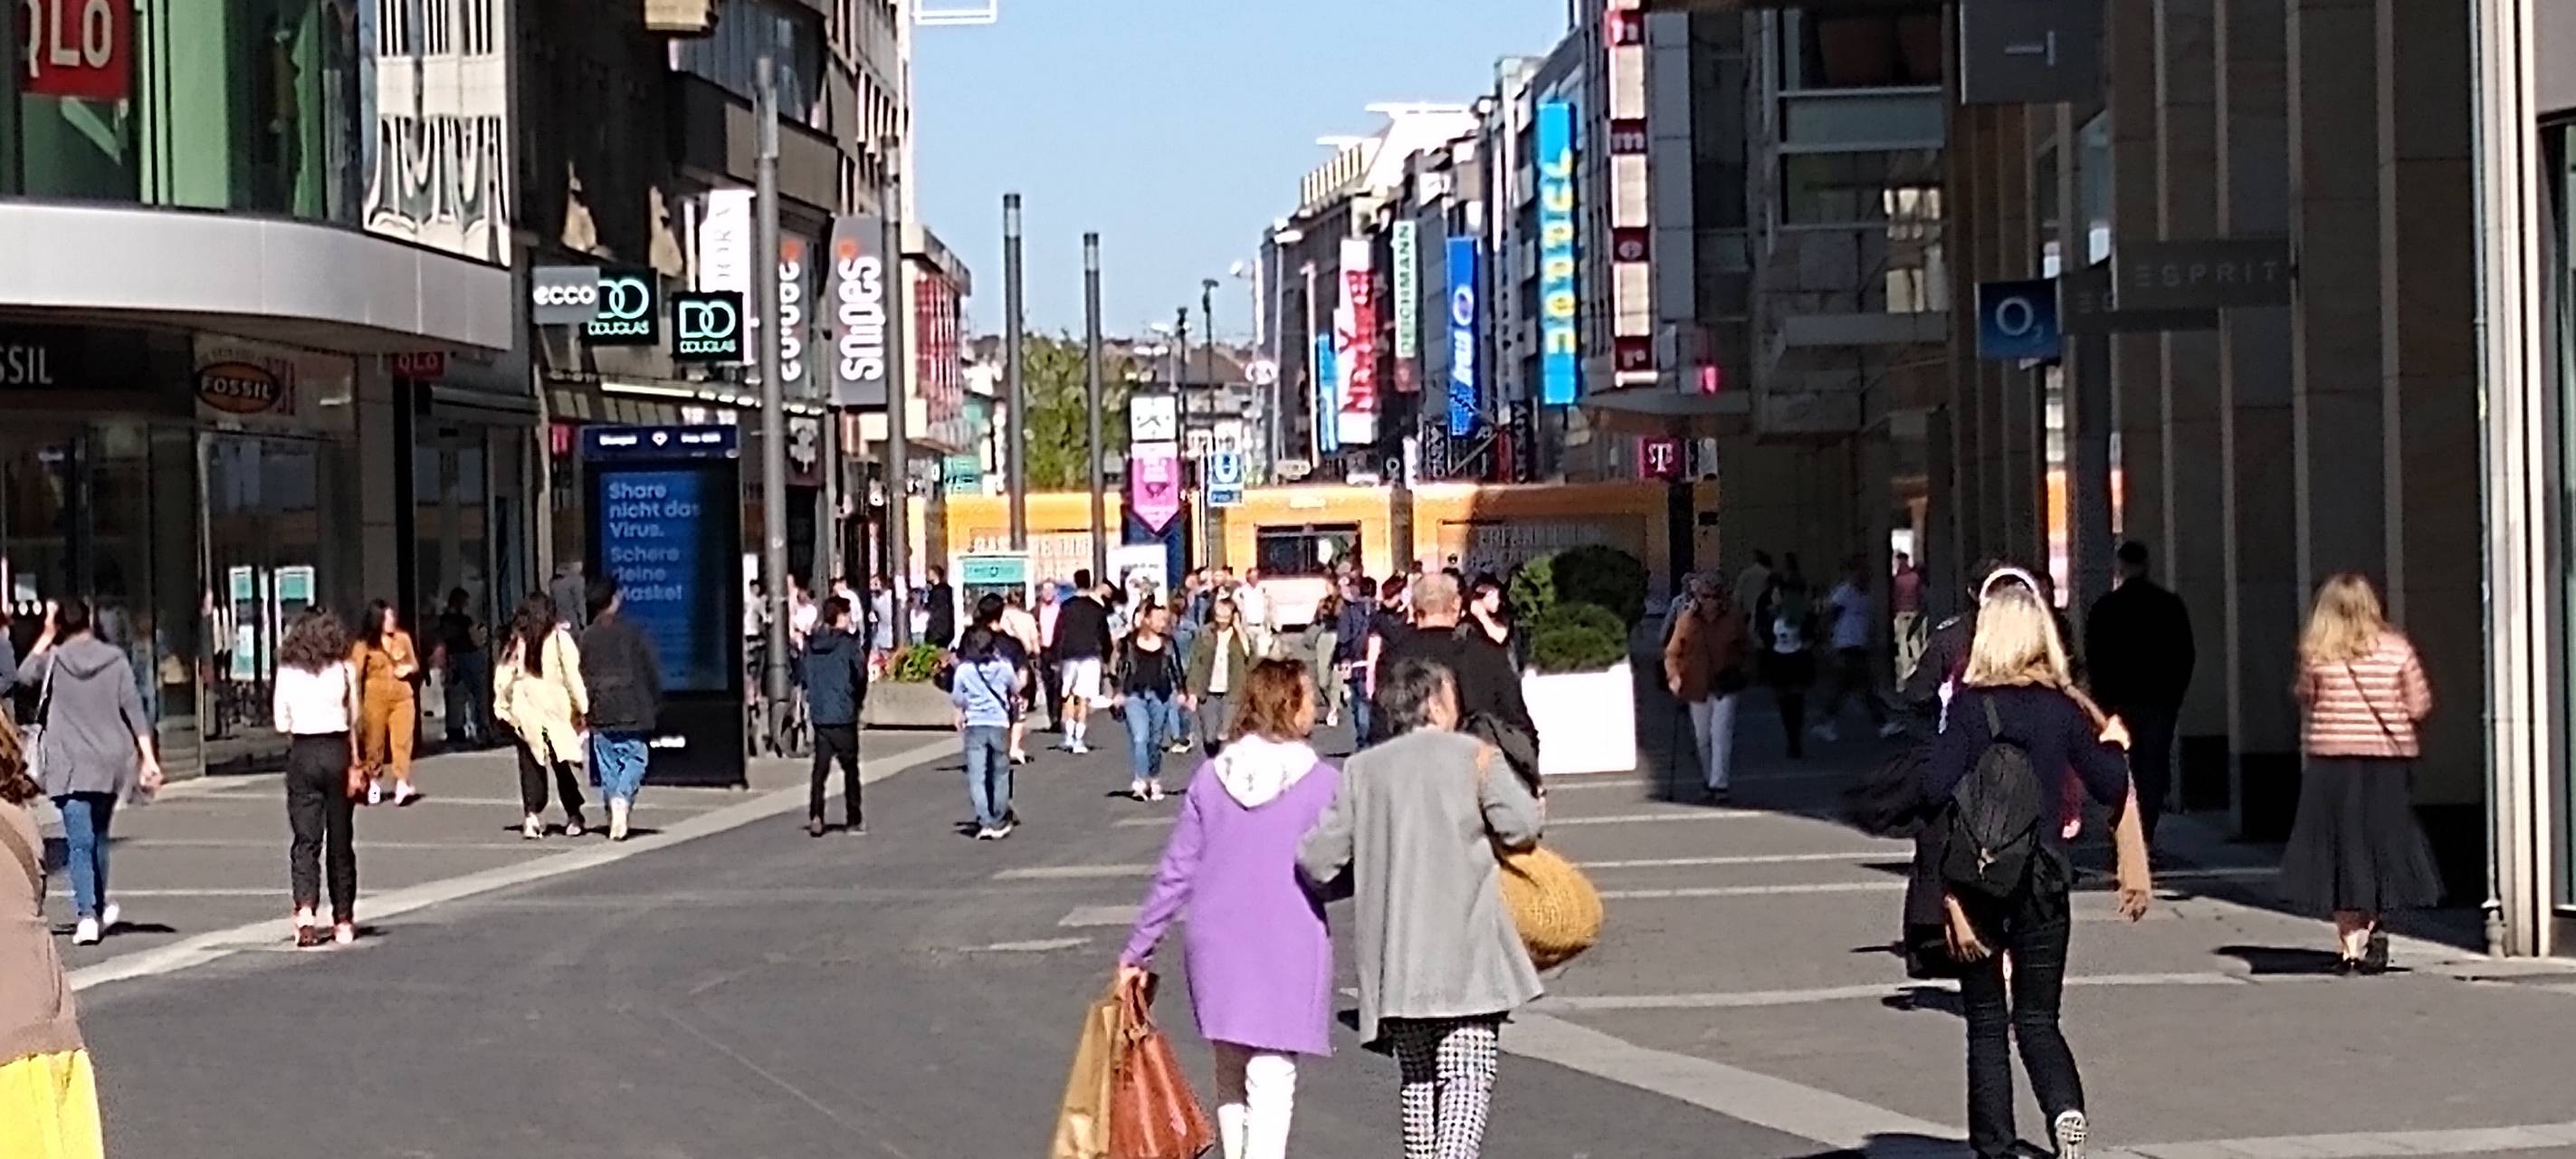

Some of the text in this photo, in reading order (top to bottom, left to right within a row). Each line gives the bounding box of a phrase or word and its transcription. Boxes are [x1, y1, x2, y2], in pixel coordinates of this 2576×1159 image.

[2133, 260, 2279, 288] ESPRIT
[533, 285, 596, 306] ecco
[1397, 224, 1412, 353] DEICHMANN
[836, 256, 886, 381] snipes
[587, 321, 651, 336] DOUGLAS
[680, 339, 737, 353] DOUGLAS
[200, 375, 272, 401] FOSSIL
[608, 482, 667, 500] Share
[609, 502, 661, 518] nicht
[609, 521, 665, 538] Virus.
[610, 545, 681, 562] Schere
